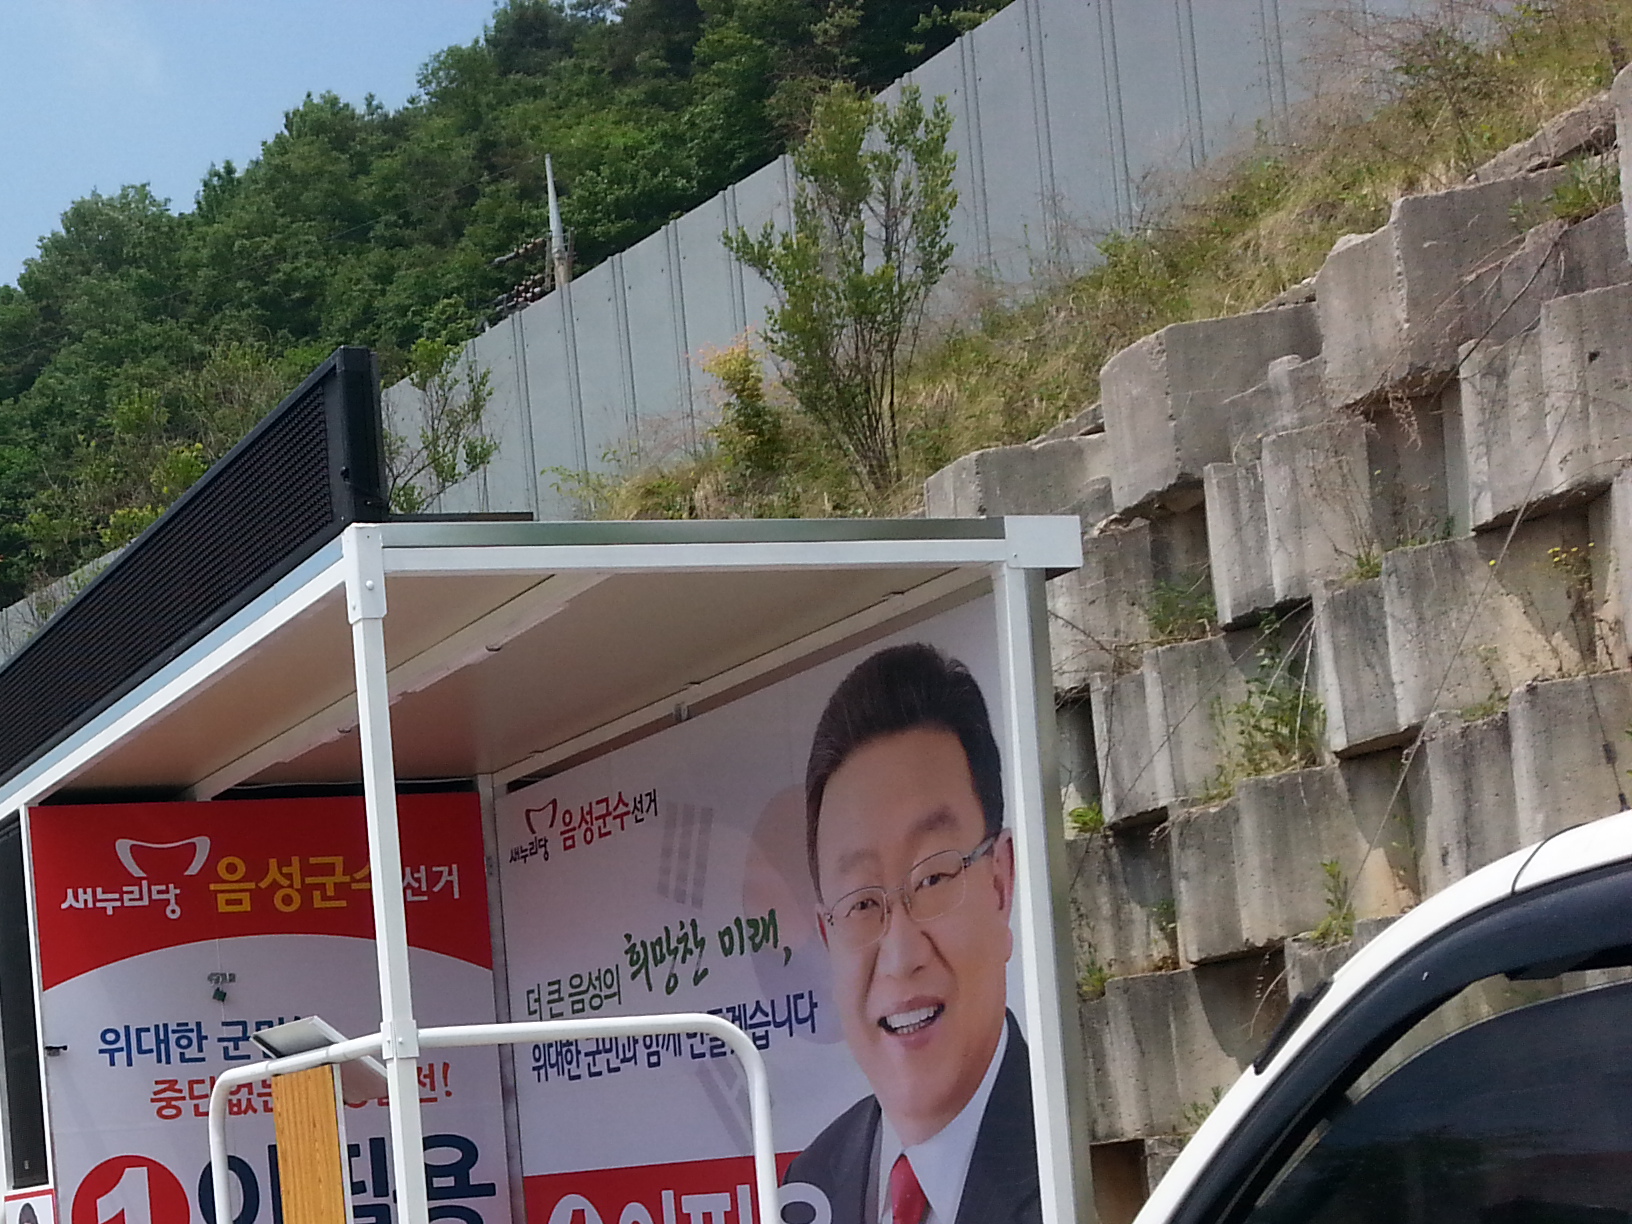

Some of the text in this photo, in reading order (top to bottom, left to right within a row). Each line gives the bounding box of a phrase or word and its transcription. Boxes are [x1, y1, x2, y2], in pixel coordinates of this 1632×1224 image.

[509, 835, 549, 864] 새누리당
[61, 880, 181, 919] 새누리당
[568, 964, 622, 1015] 음성의
[624, 917, 709, 996] 희망찬
[98, 1021, 209, 1068] 위대한
